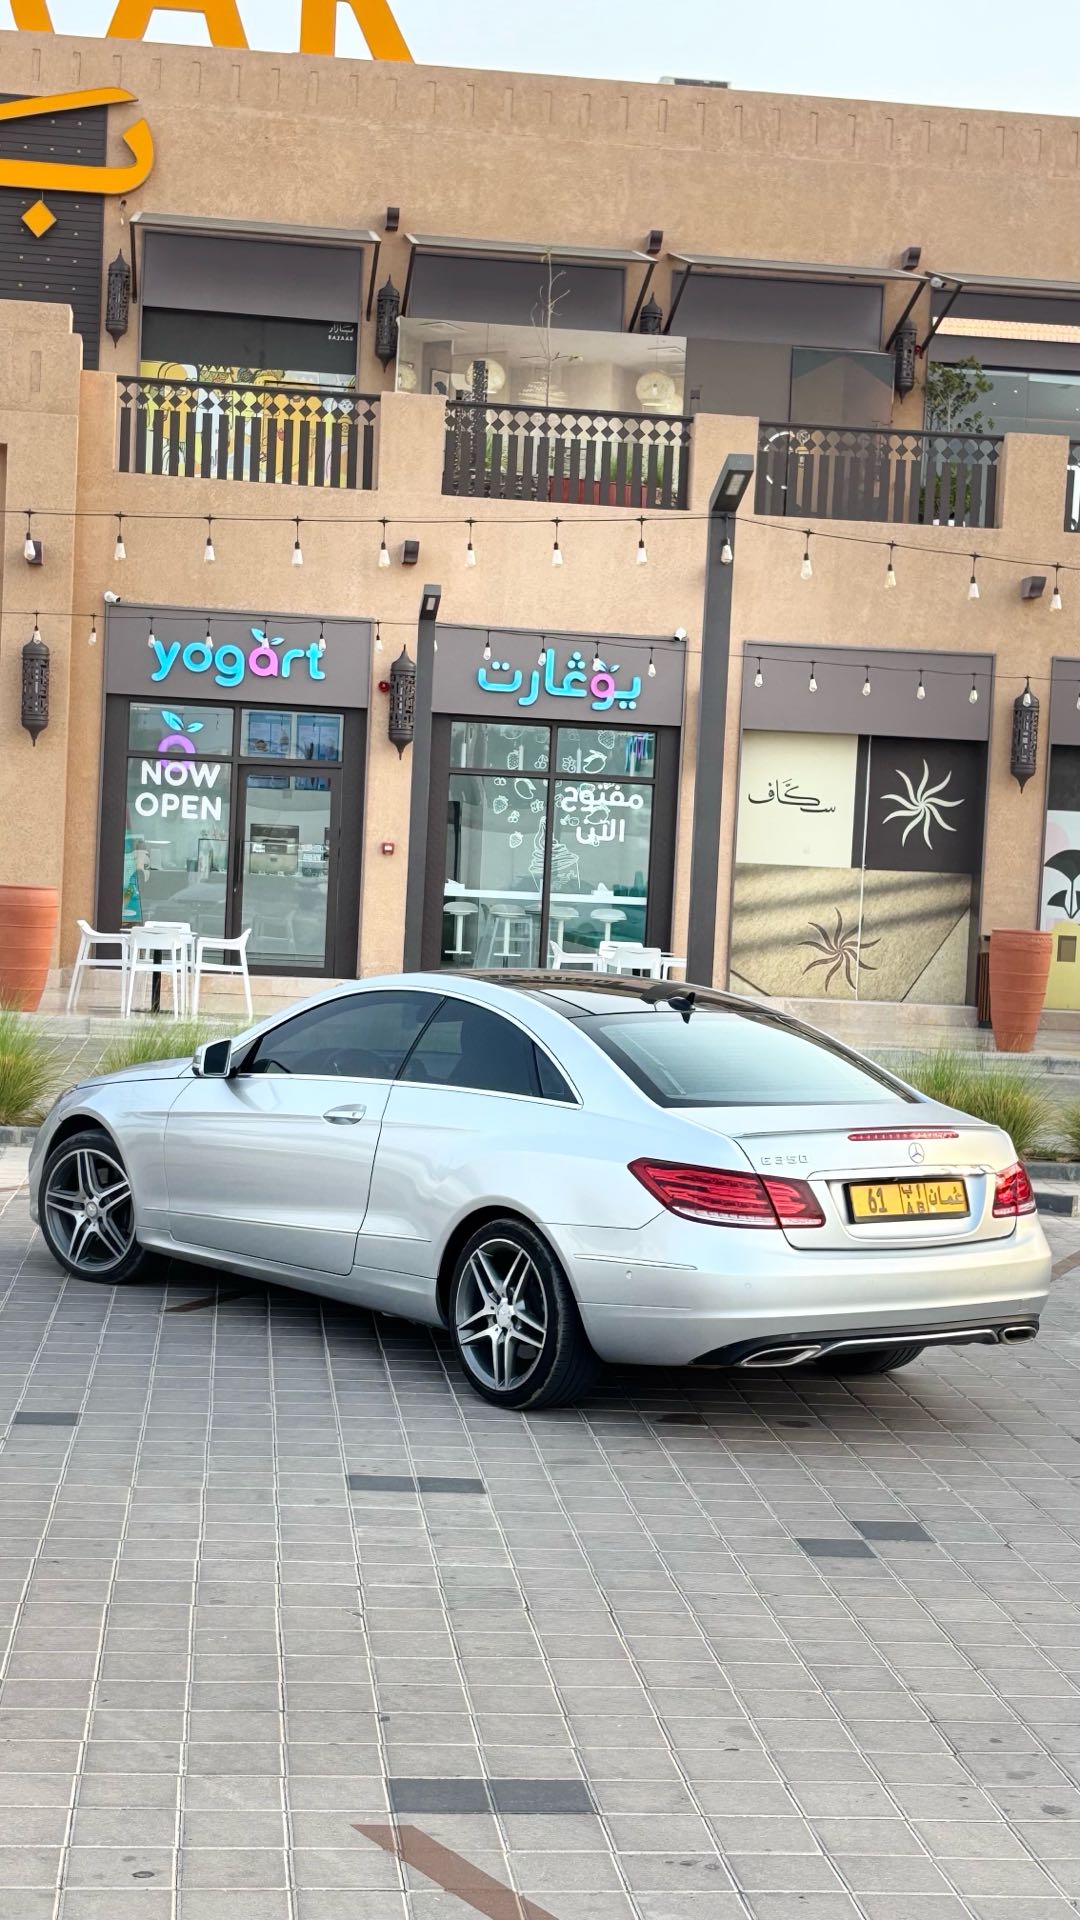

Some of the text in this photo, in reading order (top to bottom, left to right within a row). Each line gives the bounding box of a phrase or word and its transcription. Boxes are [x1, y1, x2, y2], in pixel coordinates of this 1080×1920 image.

[150, 641, 327, 688] yogart
[140, 760, 221, 789] NOW
[134, 792, 223, 822] OPEN
[561, 783, 644, 812] مفتوح
[868, 1187, 888, 1213] 61
